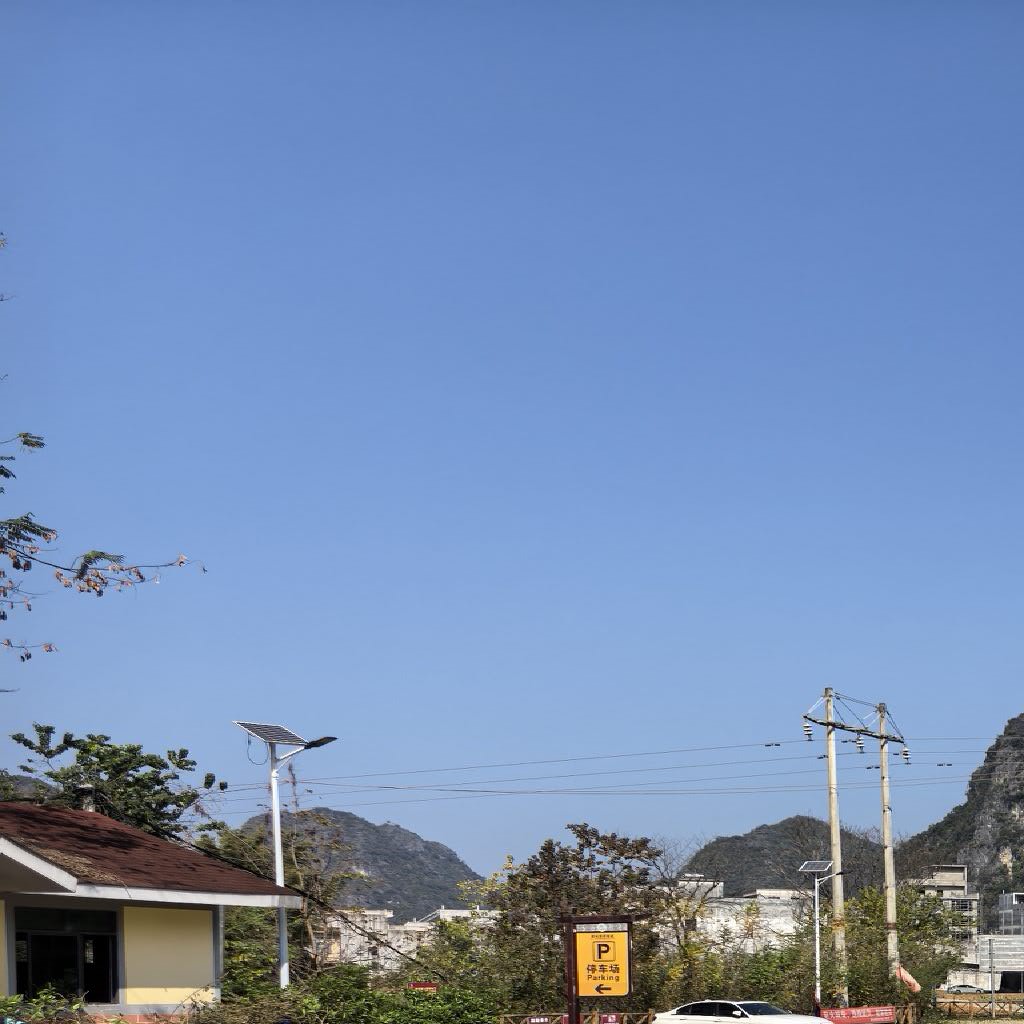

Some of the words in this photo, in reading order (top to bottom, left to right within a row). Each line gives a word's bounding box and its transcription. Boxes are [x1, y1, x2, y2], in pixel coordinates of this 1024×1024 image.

[597, 943, 610, 959] P
[587, 964, 620, 974] 停车场
[587, 974, 620, 982] Parking
